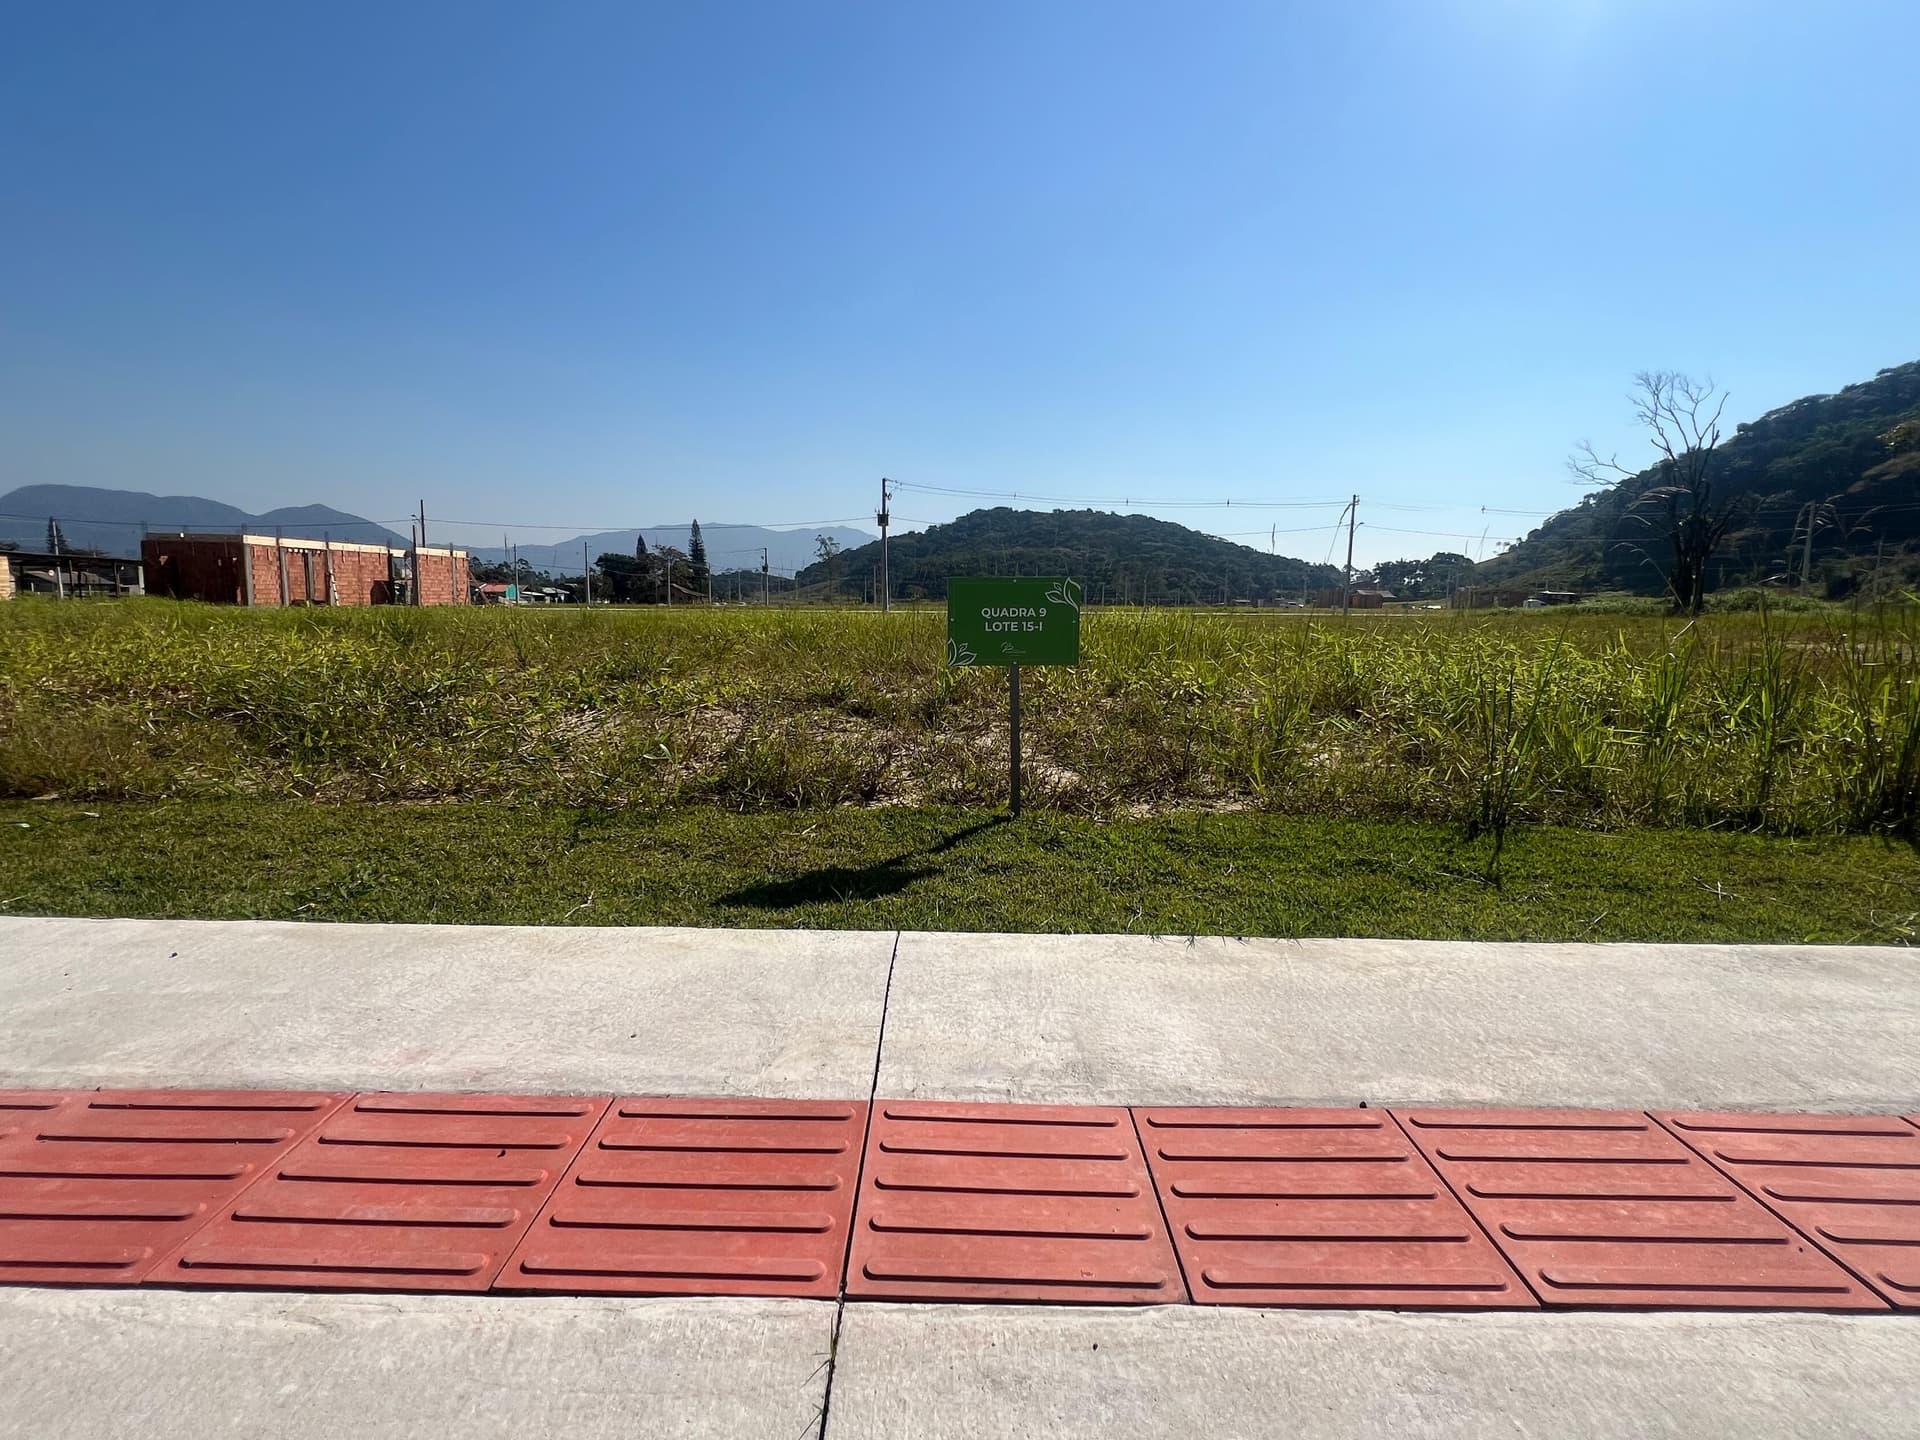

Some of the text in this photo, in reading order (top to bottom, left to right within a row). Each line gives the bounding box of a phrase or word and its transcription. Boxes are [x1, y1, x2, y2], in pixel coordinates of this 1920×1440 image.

[981, 607, 1047, 619] QUADRA 9
[985, 621, 1019, 632] LOTE
